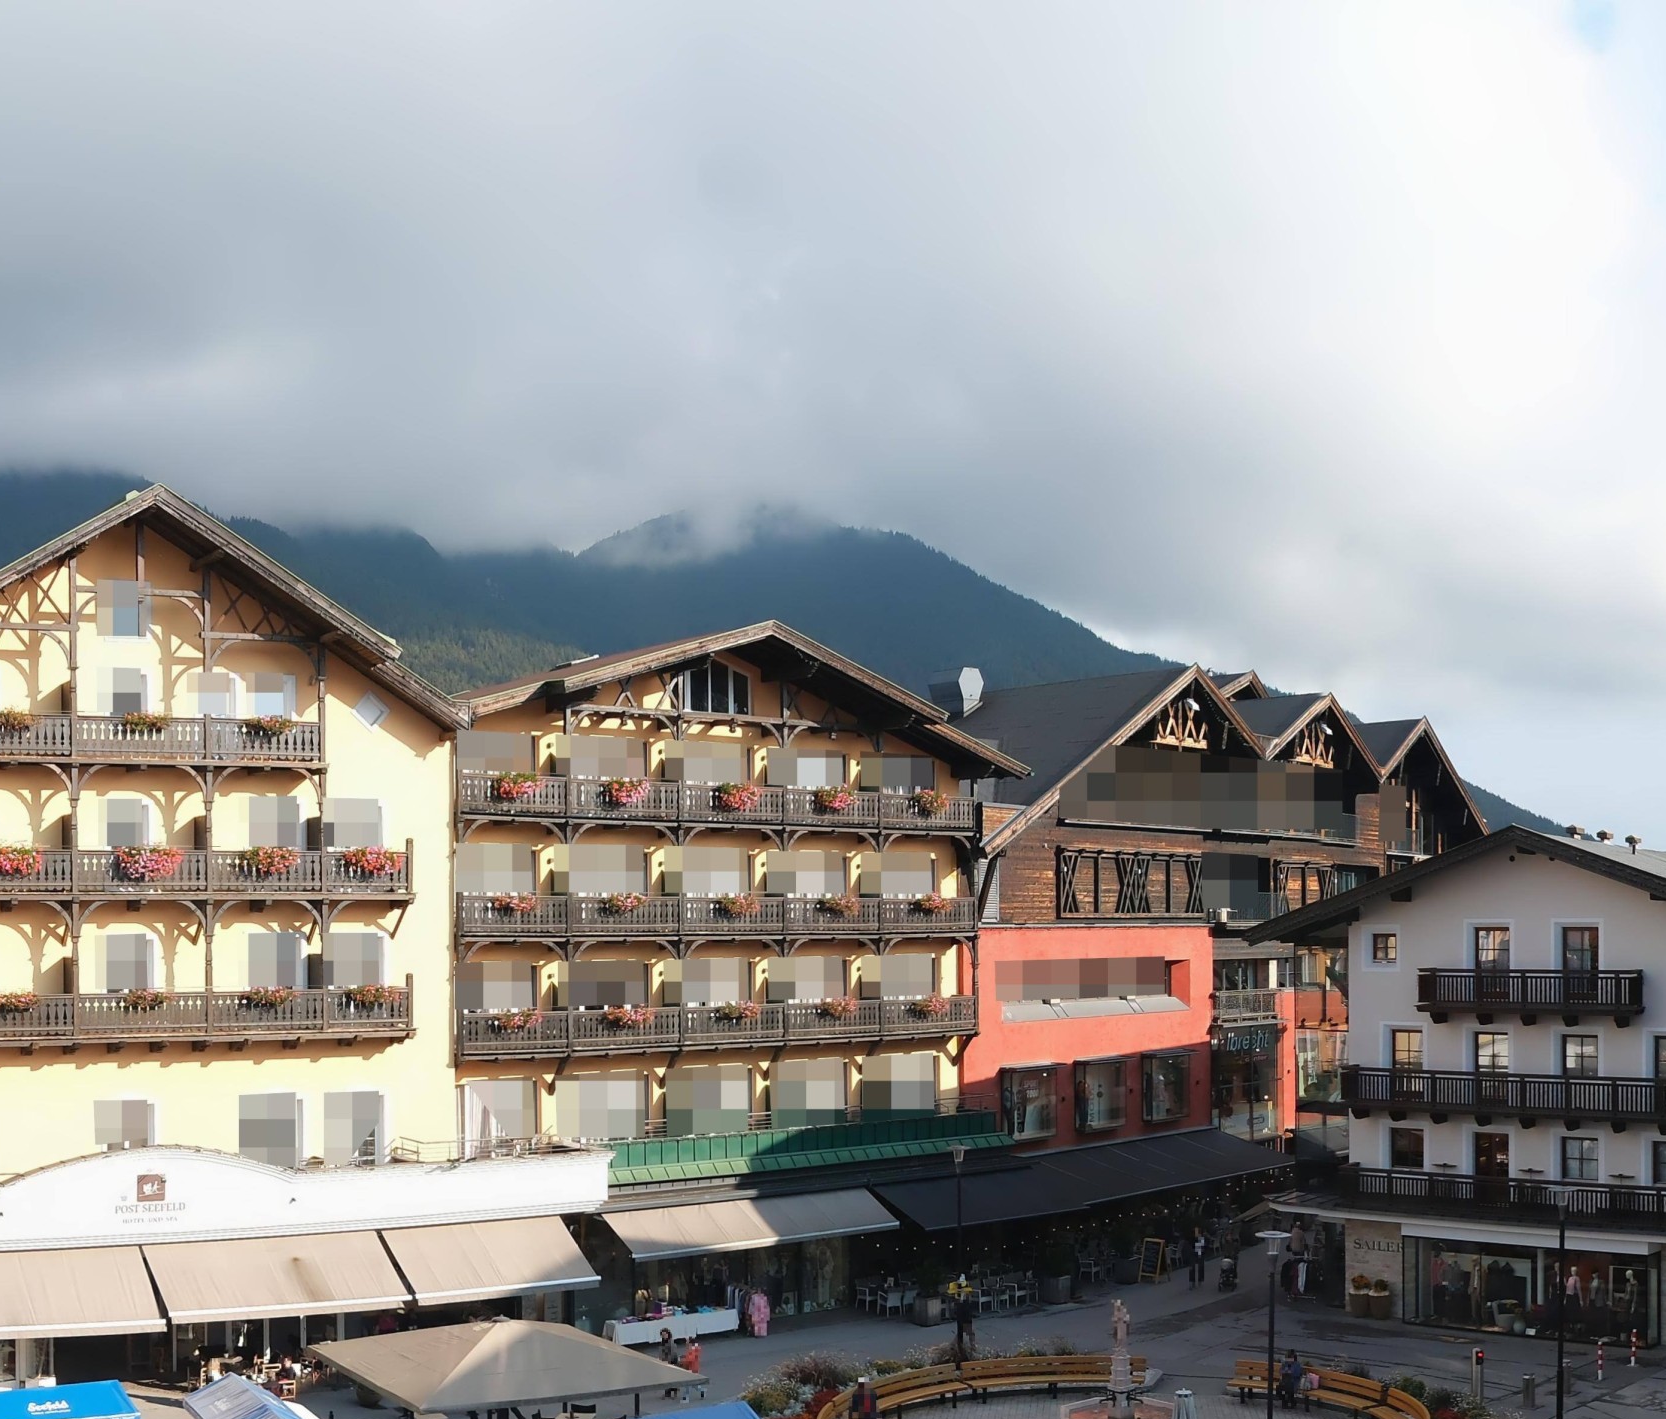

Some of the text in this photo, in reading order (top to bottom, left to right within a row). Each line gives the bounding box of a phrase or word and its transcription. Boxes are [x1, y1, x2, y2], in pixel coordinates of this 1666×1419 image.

[115, 1202, 186, 1214] POST SEEFELD
[27, 1400, 70, 1413] Seefeld
